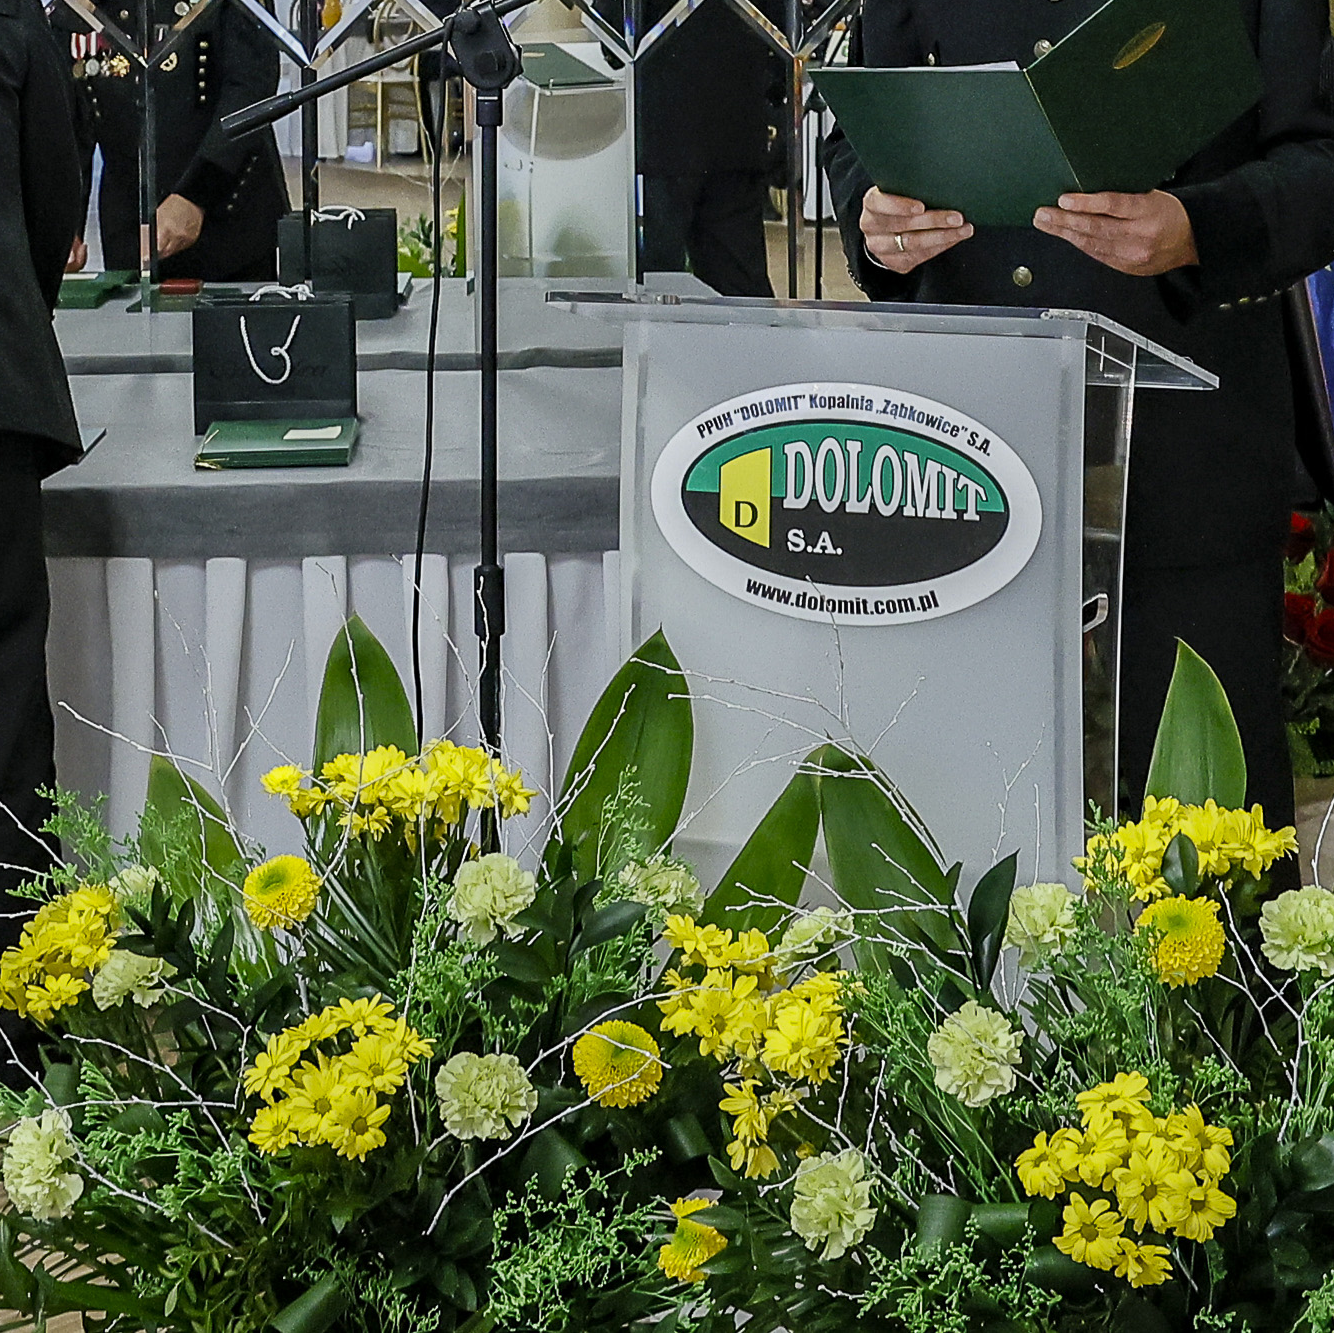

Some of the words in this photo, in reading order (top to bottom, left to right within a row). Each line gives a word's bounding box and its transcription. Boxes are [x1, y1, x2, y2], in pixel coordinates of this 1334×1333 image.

[696, 411, 735, 439] PPUH
[809, 393, 875, 412] Kopalnia
[967, 431, 991, 457] S.A.
[782, 436, 988, 522] DOLOMIT
[734, 500, 759, 528] D
[786, 527, 844, 556] S.A.
[745, 578, 940, 615] www.dolomit.com.pl
